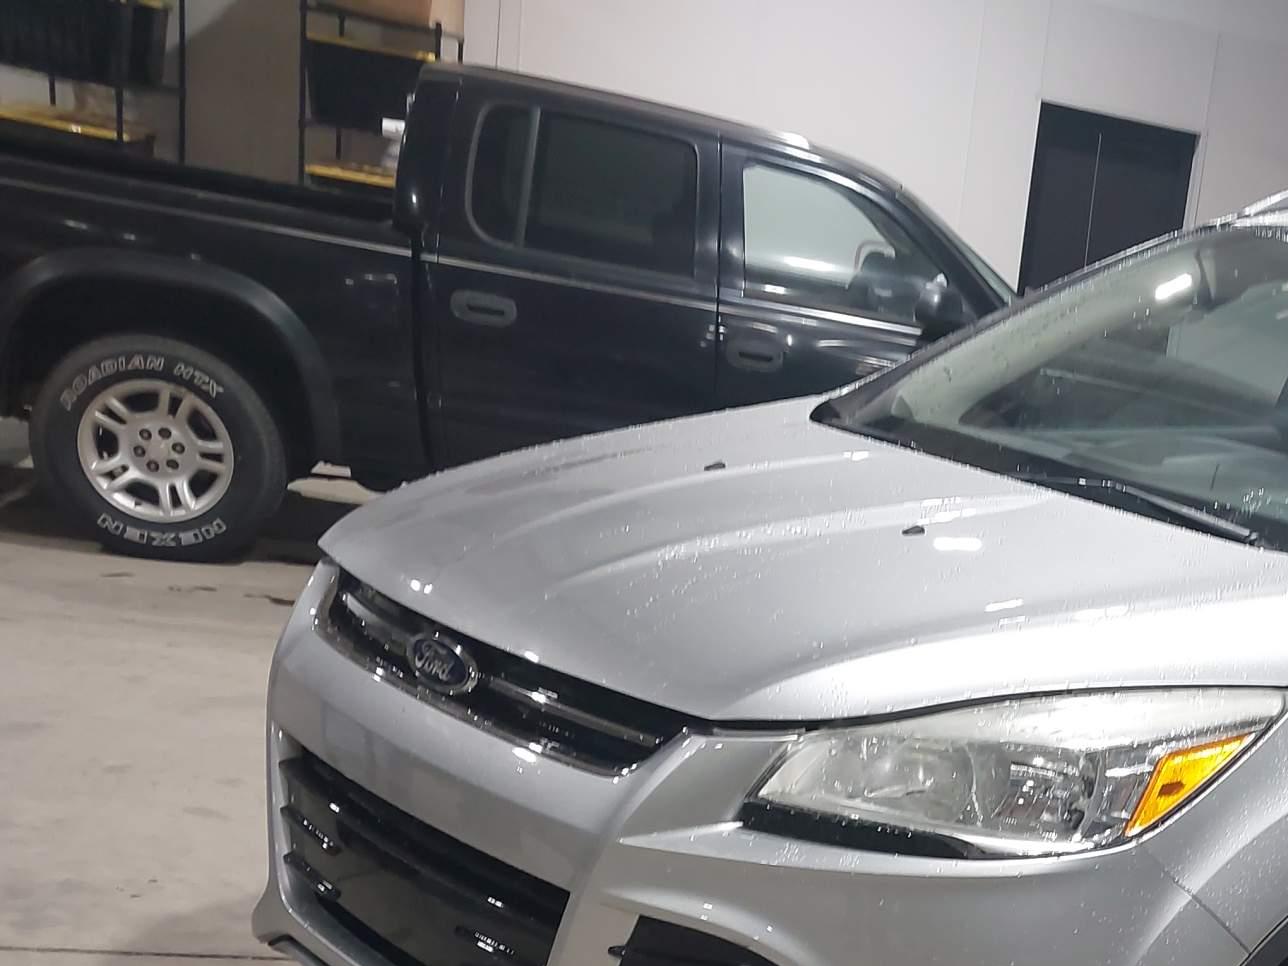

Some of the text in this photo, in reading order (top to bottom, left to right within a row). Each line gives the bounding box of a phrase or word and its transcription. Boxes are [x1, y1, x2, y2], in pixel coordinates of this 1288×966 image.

[173, 362, 224, 398] HTX
[97, 512, 227, 547] NEXEN
[415, 640, 454, 681] Ford
